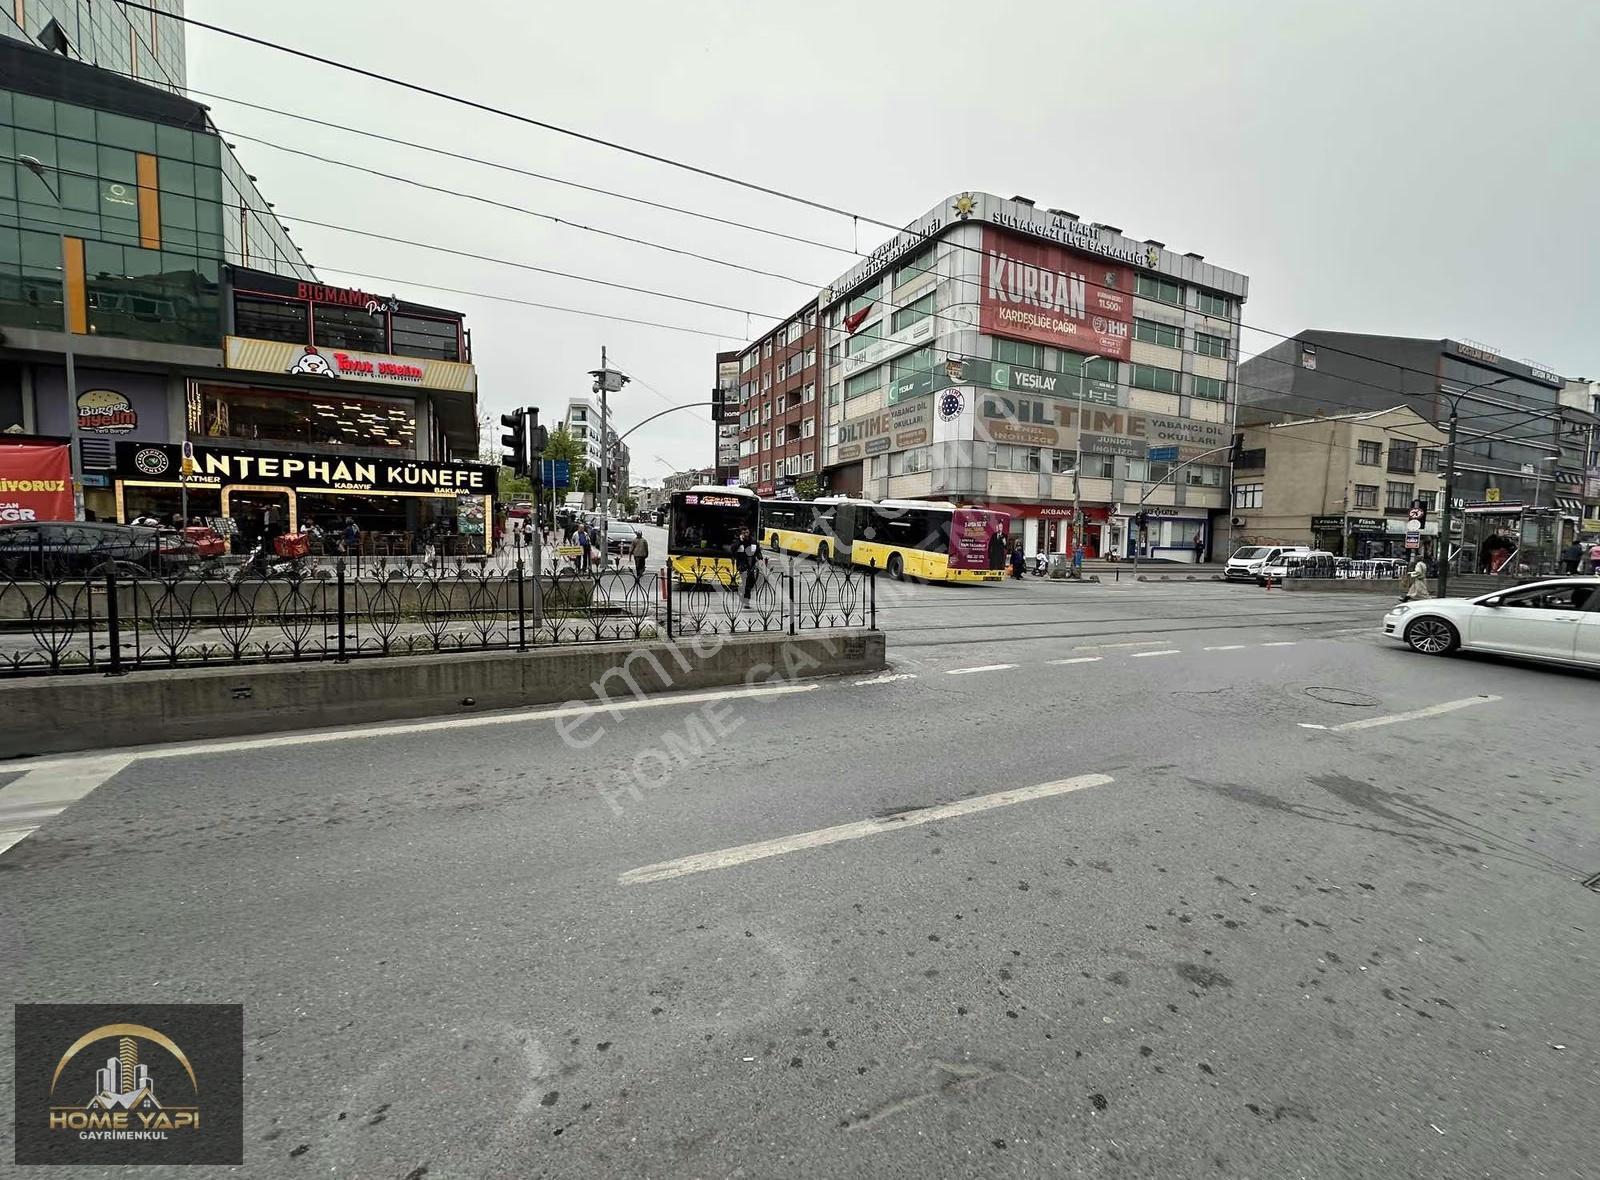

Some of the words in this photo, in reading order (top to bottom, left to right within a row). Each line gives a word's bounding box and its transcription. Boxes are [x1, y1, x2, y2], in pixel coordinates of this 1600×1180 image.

[989, 250, 1086, 320] KURBAN
[999, 306, 1050, 329] KARDEŞLİĞE
[1052, 316, 1077, 335] ÇAĞRI
[1014, 371, 1057, 392] YEŞİLAY
[80, 402, 134, 417] Burger
[891, 404, 916, 419] YABANCI
[894, 415, 924, 429] OKULLARI
[1152, 418, 1198, 433] YABANCI
[1158, 431, 1217, 446] OKULLARI
[179, 452, 376, 485] ANTEPHAN
[387, 463, 484, 488] KÜNEFE
[334, 482, 372, 491] KADAYIF
[434, 486, 471, 496] BAKLAVA
[0, 508, 36, 521] GR
[1040, 508, 1072, 516] AKBANK
